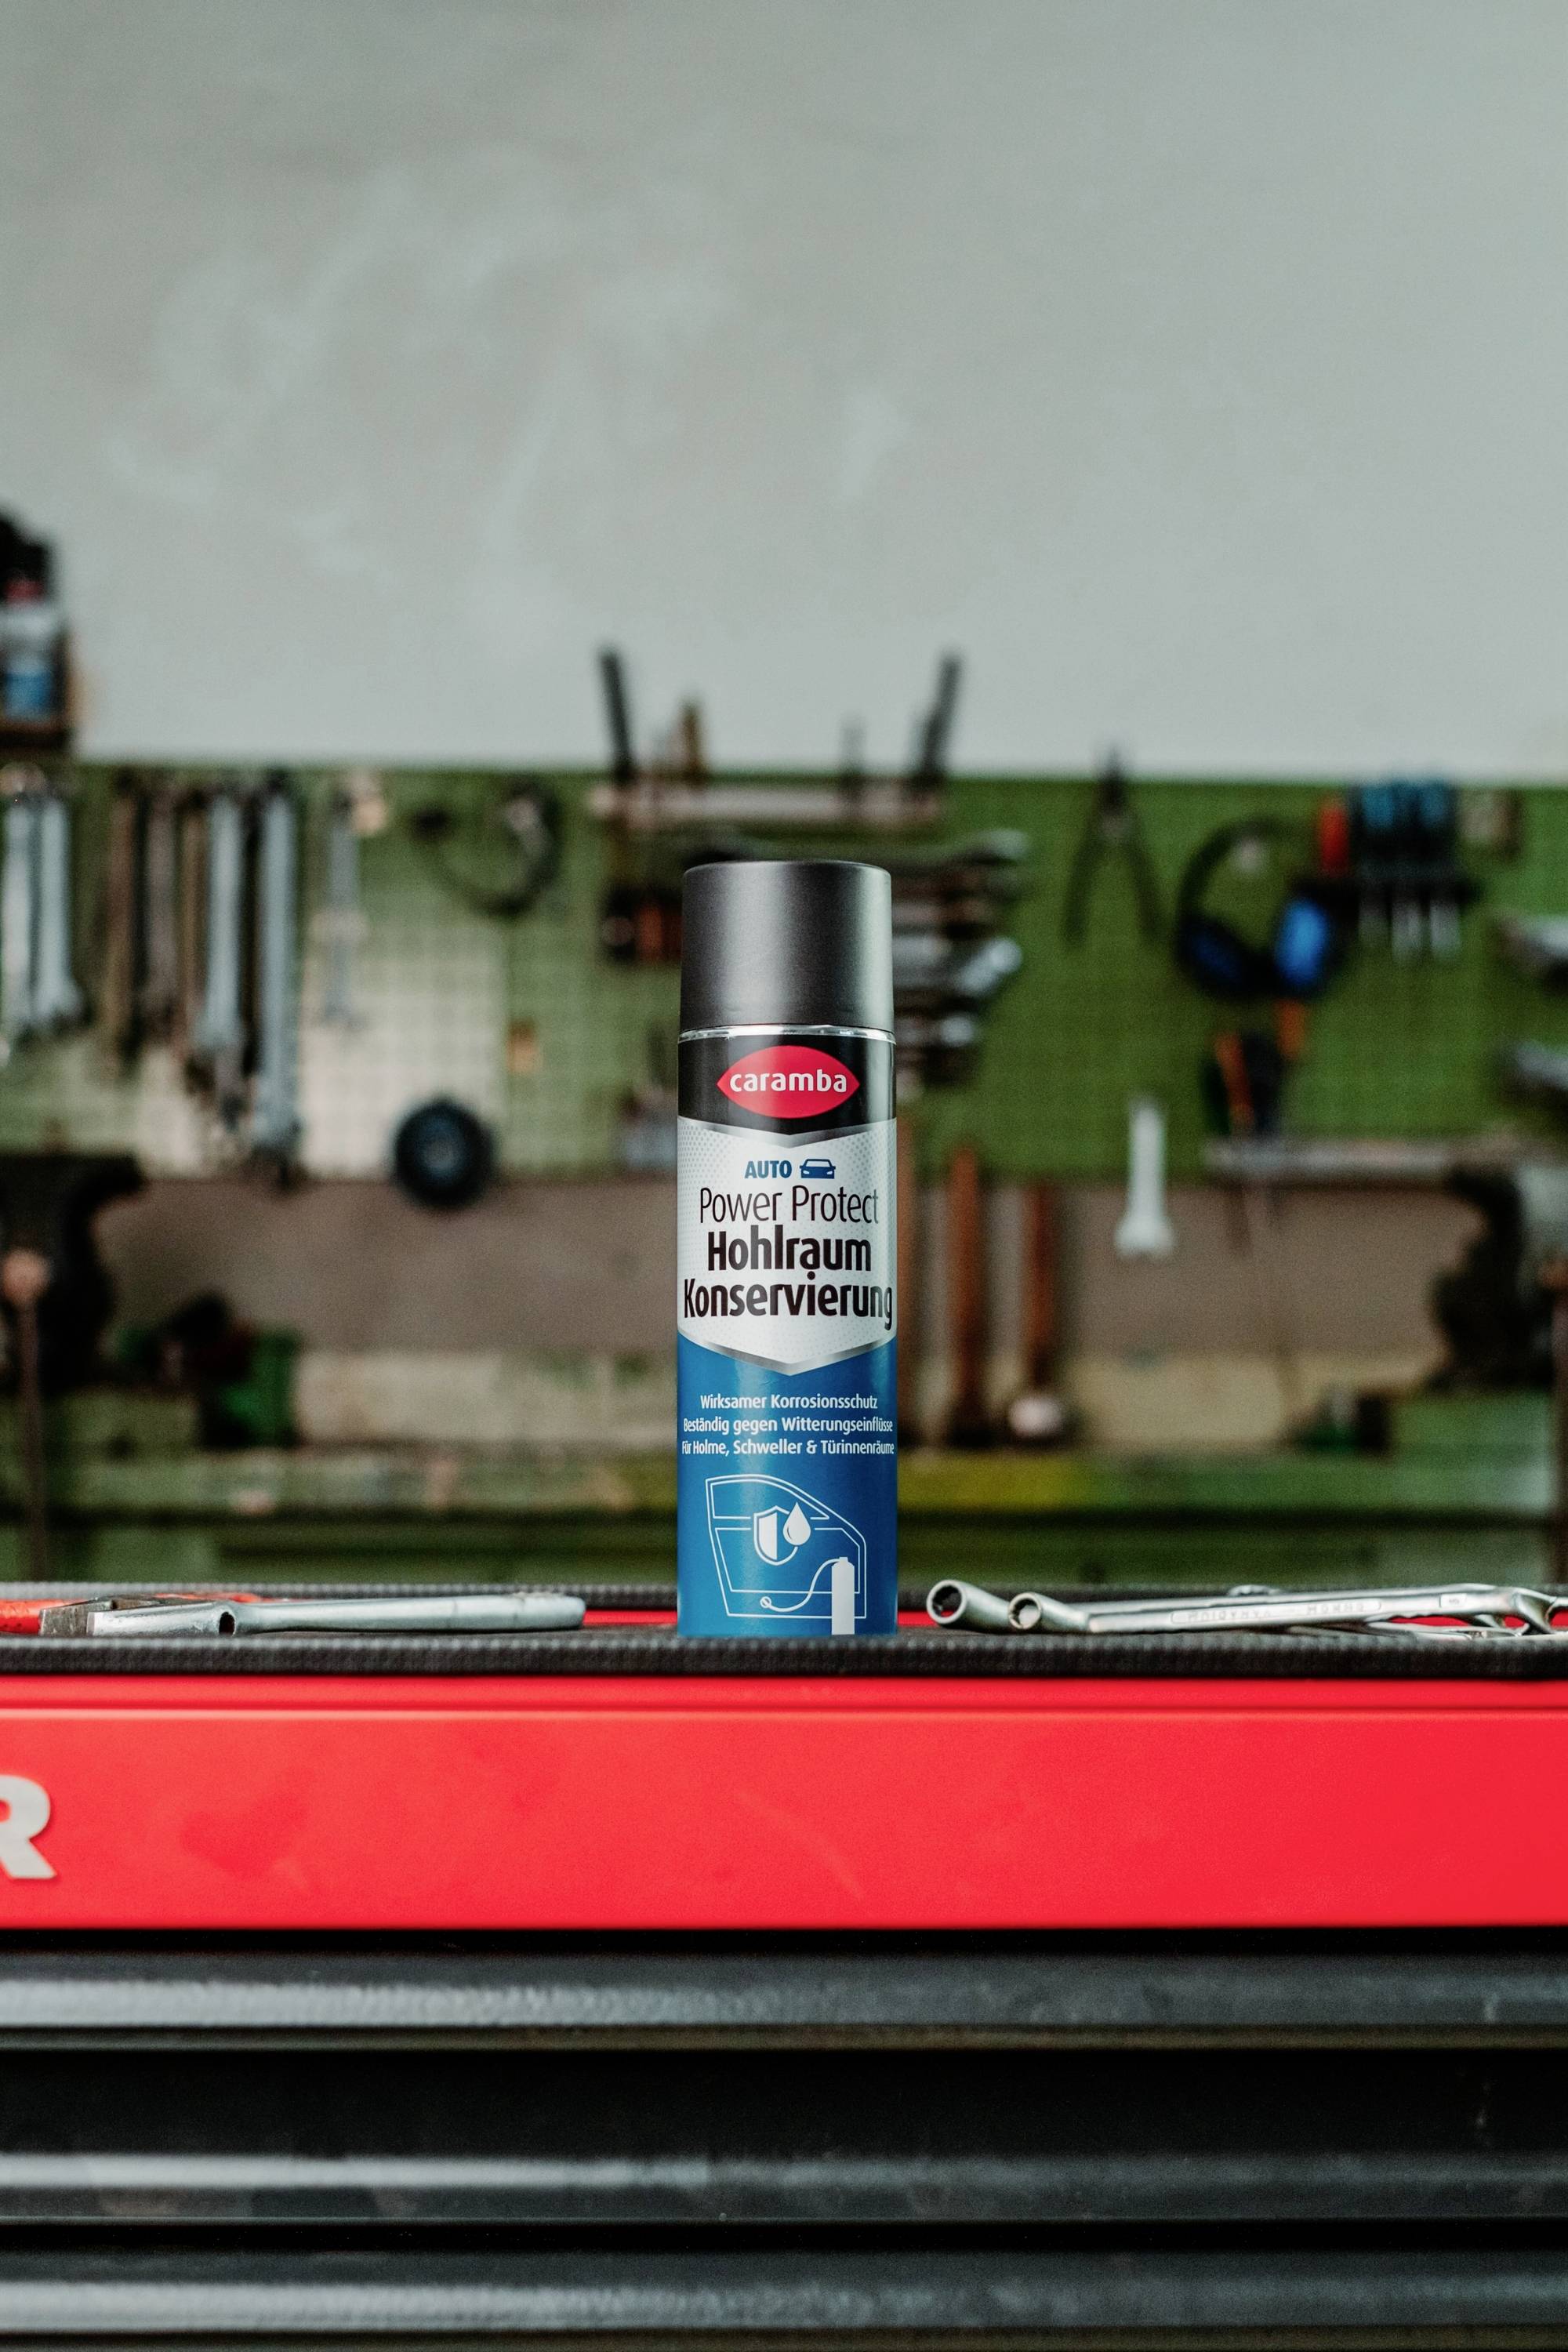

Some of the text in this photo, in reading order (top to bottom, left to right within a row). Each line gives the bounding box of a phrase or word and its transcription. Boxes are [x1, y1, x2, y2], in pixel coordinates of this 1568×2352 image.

[730, 1069, 847, 1092] caramba
[745, 1160, 793, 1179] AUTO
[700, 1185, 879, 1224] Power Protect
[708, 1225, 871, 1271] Hohlraum
[684, 1271, 892, 1330] Konservierung
[700, 1393, 878, 1409] Wirksamer Korrosionsschutz
[683, 1416, 893, 1436] Beständig gegen Witterungseinflüsse
[682, 1439, 895, 1457] Für Holme, Schweller & Türinnenräume
